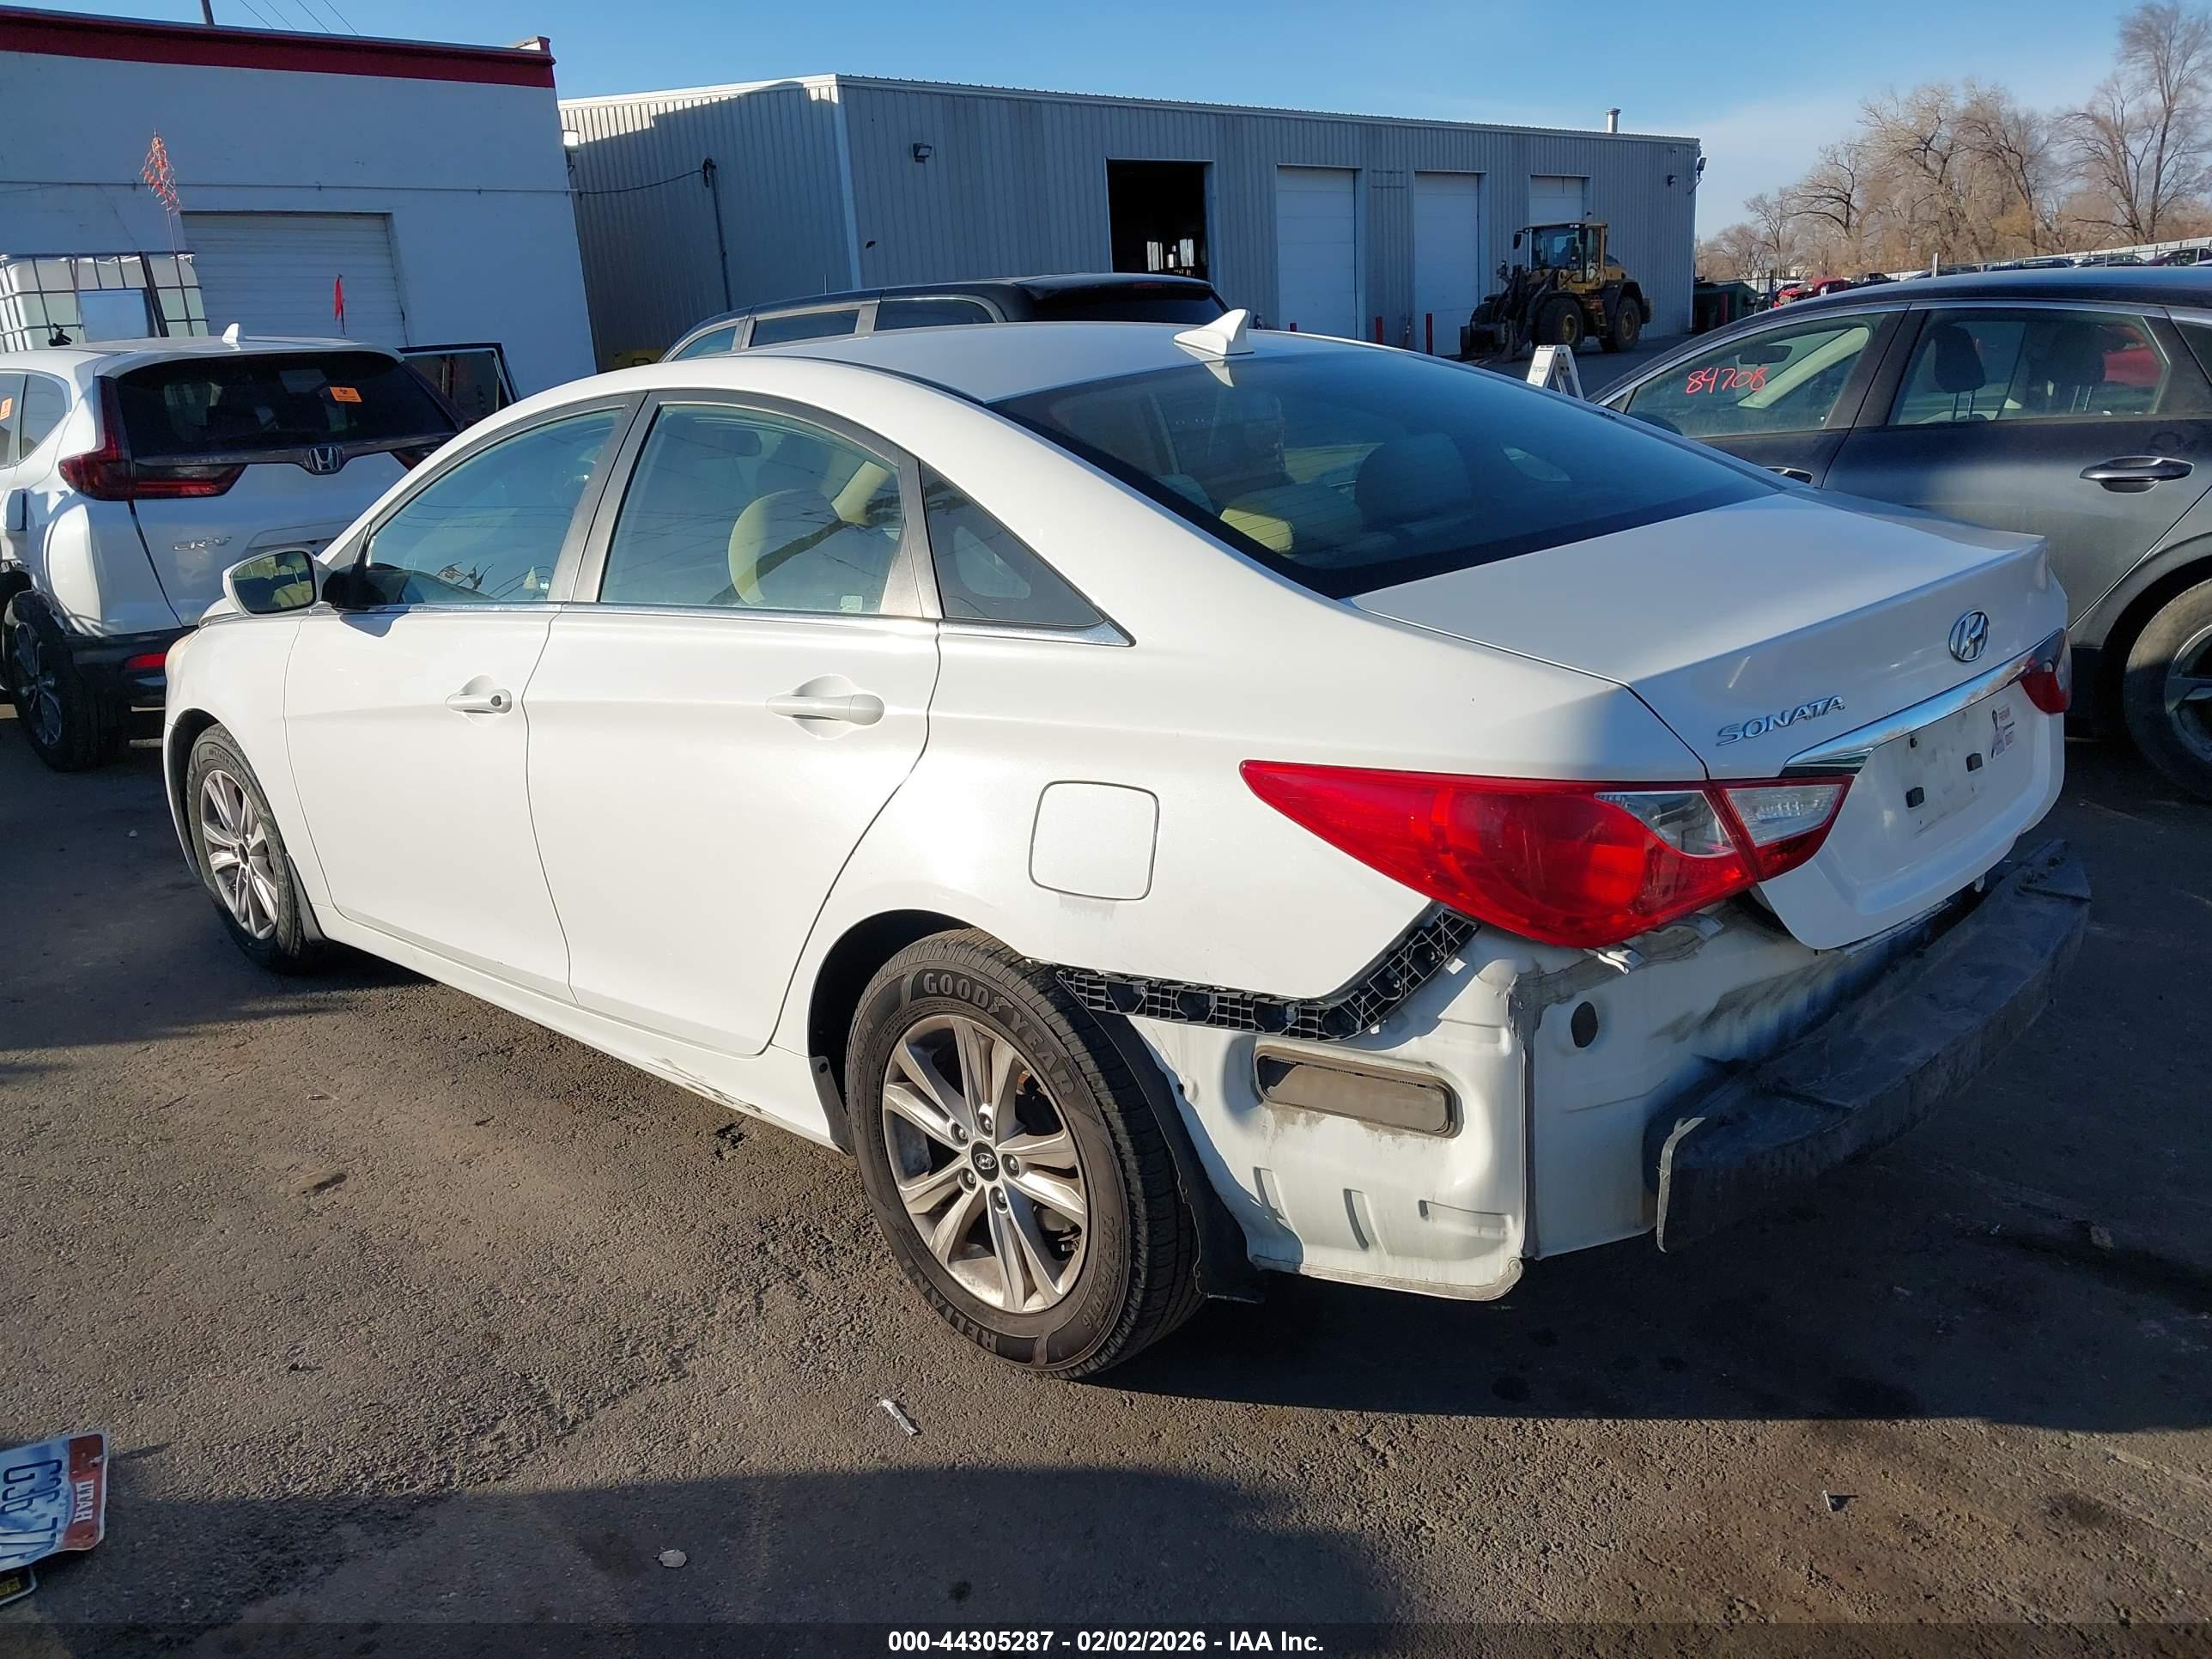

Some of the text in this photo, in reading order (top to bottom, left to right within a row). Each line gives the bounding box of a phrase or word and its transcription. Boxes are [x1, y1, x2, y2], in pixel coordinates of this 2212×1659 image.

[1686, 366, 1770, 395] 84708
[1716, 695, 1846, 747] SONATA
[922, 972, 1076, 1097] GOODYEAR
[73, 1479, 94, 1524] UTAH
